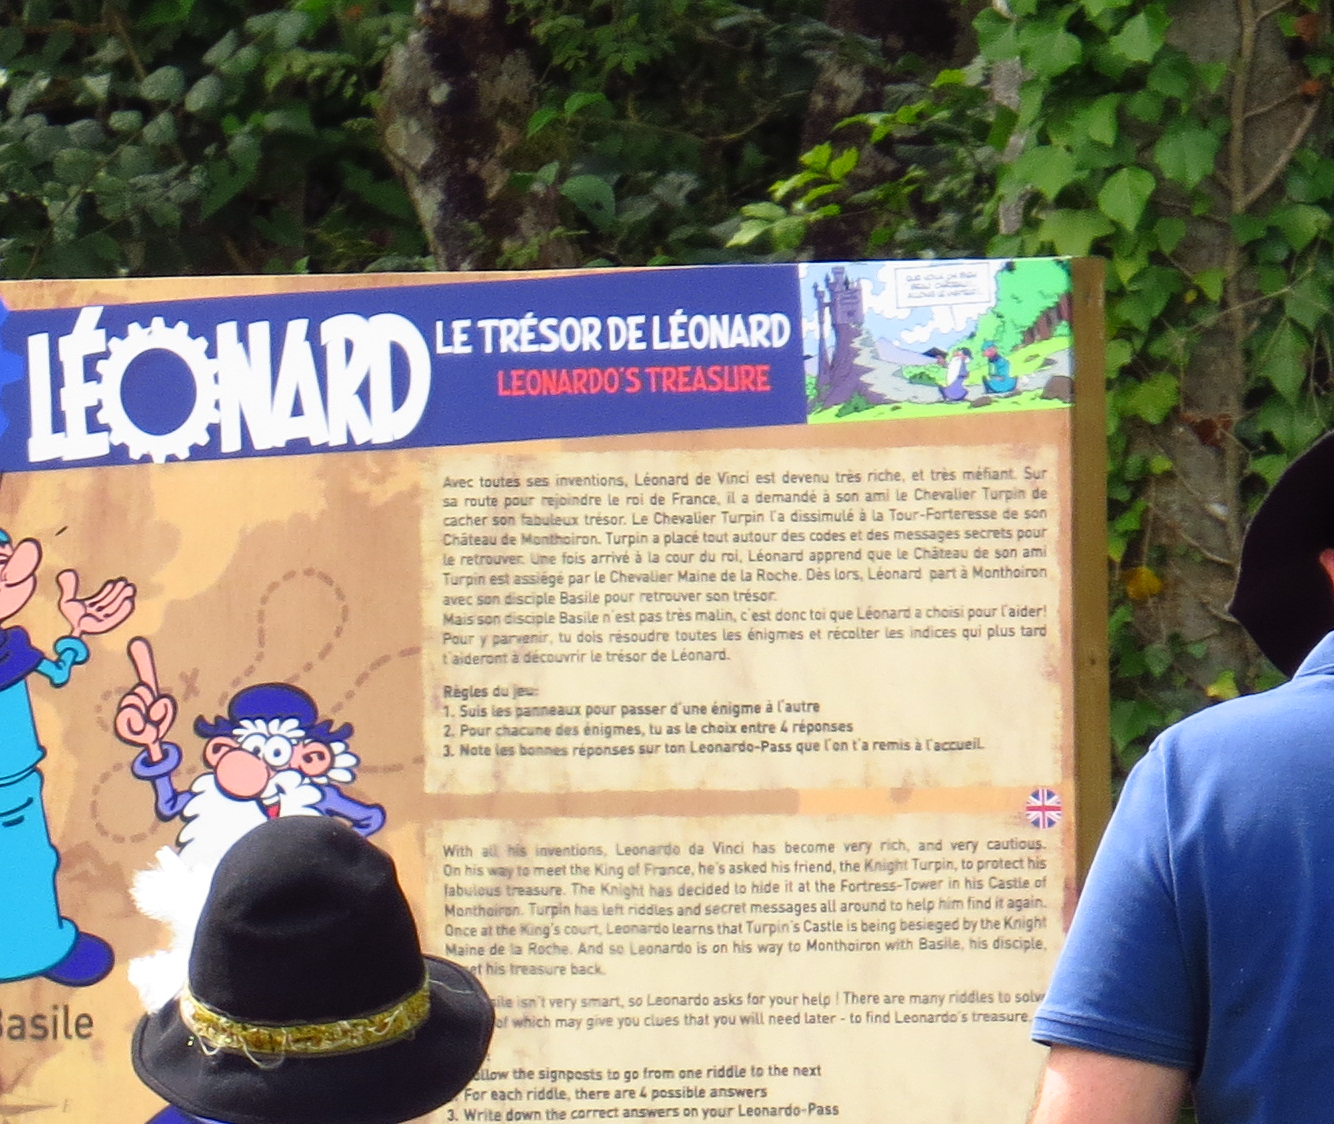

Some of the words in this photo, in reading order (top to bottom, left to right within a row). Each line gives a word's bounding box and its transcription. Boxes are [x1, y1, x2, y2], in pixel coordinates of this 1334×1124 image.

[435, 319, 472, 355] LE
[478, 312, 602, 354] TRÉSOR
[607, 315, 647, 351] DE
[652, 309, 791, 350] LÉONARD
[27, 305, 431, 463] LÉONARD
[496, 366, 642, 396] LEONARDO'S
[644, 364, 772, 393] TREASURE
[443, 474, 473, 488] Avec
[633, 471, 689, 485] Léonard
[717, 470, 749, 484] Vinci
[781, 469, 829, 483] devenu
[835, 469, 862, 483] très
[1023, 467, 1047, 480] Sur
[503, 495, 534, 510] pour
[755, 489, 817, 503] demandé
[835, 491, 859, 502] son
[913, 487, 976, 502] Chevalier
[981, 487, 1027, 504] Turpin
[443, 512, 488, 527] cacher
[653, 509, 715, 524] Chevalier
[721, 509, 765, 526] Turpin
[790, 508, 854, 523] dissimulé
[889, 506, 997, 521] Tour-Forteresse
[1023, 509, 1047, 520] son
[606, 530, 649, 547] Turpin
[663, 529, 699, 547] placé
[702, 530, 729, 543] tout
[732, 530, 777, 543] autour
[809, 528, 846, 542] codes
[893, 530, 961, 544] messages
[963, 527, 1013, 540] secrets
[1016, 529, 1047, 543] pour
[591, 549, 629, 564] arrivé
[665, 552, 695, 563] cour
[747, 547, 804, 562] Léonard
[809, 547, 863, 564] apprend
[866, 550, 891, 564] que
[913, 546, 969, 560] Château
[994, 548, 1017, 559] son
[443, 571, 487, 588] Turpin
[609, 569, 673, 583] Chevalier
[677, 568, 717, 583] Maine
[805, 567, 831, 581] Dès
[867, 566, 923, 581] Léonard
[929, 567, 957, 583] part
[971, 564, 1047, 579] Monthoiron
[559, 590, 600, 605] Basile
[603, 593, 634, 607] pour
[639, 591, 701, 604] retrouver
[559, 609, 599, 624] Basile
[639, 612, 663, 626] pas
[665, 608, 692, 622] très
[775, 607, 807, 621] donc
[829, 609, 853, 623] que
[856, 605, 911, 620] Léonard
[925, 605, 965, 619] choisi
[967, 608, 997, 622] pour
[443, 631, 474, 645] Pour
[576, 629, 603, 643] dois
[608, 628, 669, 643] résoudre
[675, 629, 717, 642] toutes
[747, 627, 803, 644] énigmes
[827, 626, 879, 640] récolter
[987, 624, 1015, 641] plus
[1020, 624, 1047, 638] tard
[605, 648, 646, 662] trésor
[442, 683, 489, 701] Règles
[459, 703, 487, 718] Suis
[585, 705, 615, 719] pour
[620, 704, 665, 718] passer
[711, 700, 761, 717] énigme
[459, 723, 491, 737] Pour
[701, 720, 737, 734] choix
[740, 721, 776, 734] entre
[791, 719, 853, 736] réponses
[572, 741, 635, 758] réponses
[689, 738, 792, 754] Leonardo-Pass
[795, 741, 821, 755] que
[872, 737, 911, 751] remis
[615, 841, 681, 856] Leonardo
[712, 840, 744, 855] Vinci
[751, 840, 775, 854] has
[784, 839, 835, 854] become
[843, 842, 872, 856] very
[533, 863, 567, 876] meet
[729, 859, 767, 874] asked
[975, 858, 1025, 874] protect
[677, 879, 729, 894] decided
[751, 878, 780, 893] hide
[839, 876, 943, 892] Fortress-Tower
[987, 875, 1030, 890] Castle
[528, 901, 571, 919] Turpin
[704, 900, 747, 913] secret
[749, 901, 817, 916] messages
[839, 897, 887, 912] around
[905, 897, 935, 914] help
[967, 896, 991, 910] find
[605, 920, 669, 934] Leonardo
[671, 919, 714, 933] learns
[716, 919, 743, 933] that
[803, 917, 843, 932] Castle
[860, 917, 897, 934] being
[899, 916, 959, 934] besieged
[445, 941, 485, 956] Maine
[577, 940, 603, 955] And
[629, 939, 692, 954] Leonardo
[757, 942, 783, 956] way
[805, 938, 881, 952] Monthoiron
[885, 937, 913, 952] with
[509, 962, 567, 975] treasure
[549, 997, 577, 1011] very
[646, 993, 709, 1007] Leonardo
[769, 995, 799, 1009] your
[843, 991, 879, 1005] There
[909, 994, 945, 1008] many
[1015, 990, 1045, 1004] solv
[511, 1013, 551, 1028] which
[643, 1012, 679, 1026] clues
[683, 1012, 709, 1026] that
[739, 1011, 764, 1025] will
[768, 1011, 801, 1025] need
[865, 1010, 891, 1024] find
[537, 1065, 603, 1082] signposts
[643, 1064, 675, 1078] from
[706, 1063, 747, 1078] riddle
[793, 1064, 821, 1077] next
[490, 1086, 523, 1101] each
[575, 1086, 610, 1100] there
[651, 1085, 706, 1102] possible
[709, 1087, 767, 1099] answers
[463, 1107, 504, 1121] Write
[505, 1106, 542, 1121] down
[570, 1106, 619, 1120] correct
[622, 1107, 680, 1119] answers
[701, 1106, 734, 1121] your
[737, 1102, 839, 1117] Leonardo-Pass
